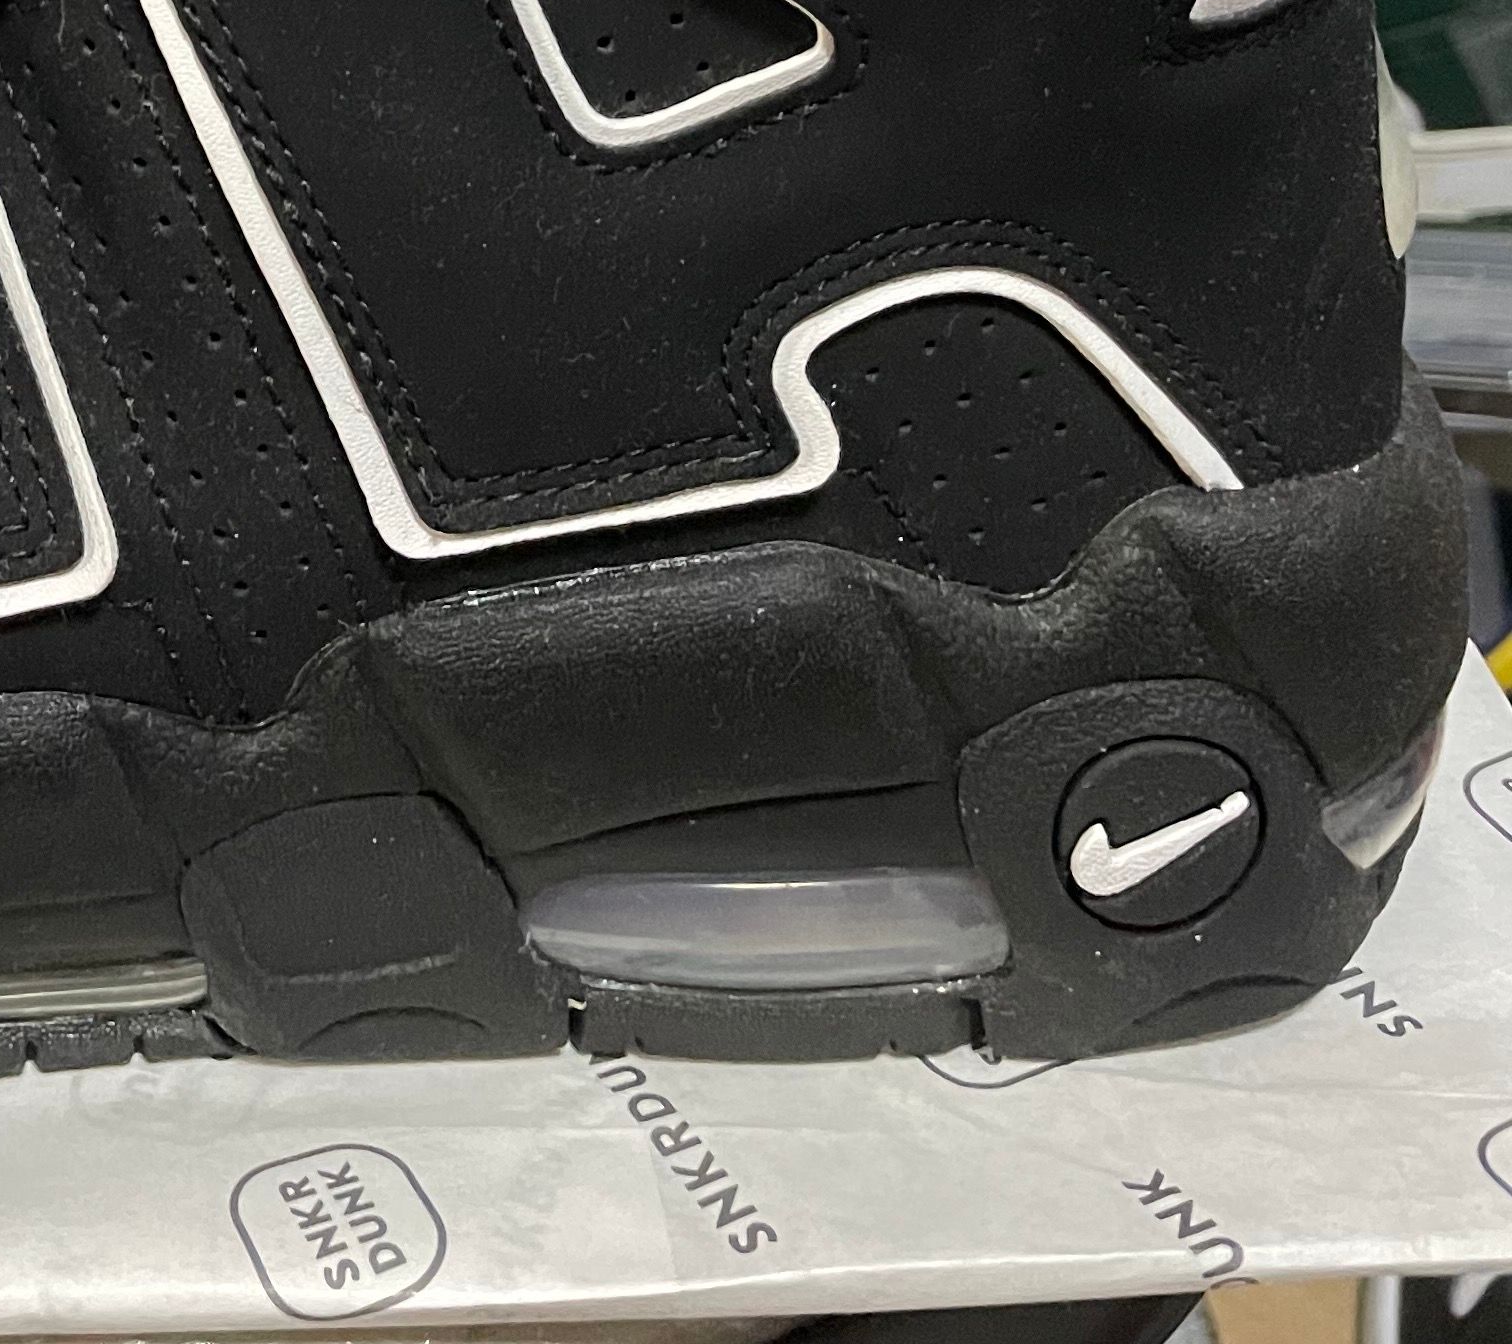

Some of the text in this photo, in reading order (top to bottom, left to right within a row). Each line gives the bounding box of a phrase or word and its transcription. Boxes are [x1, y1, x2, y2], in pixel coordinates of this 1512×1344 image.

[589, 1053, 779, 1254] SNKRDU
[278, 1175, 361, 1290] SNKR
[316, 1161, 408, 1275] DUNK
[1121, 1168, 1258, 1290] UNK
